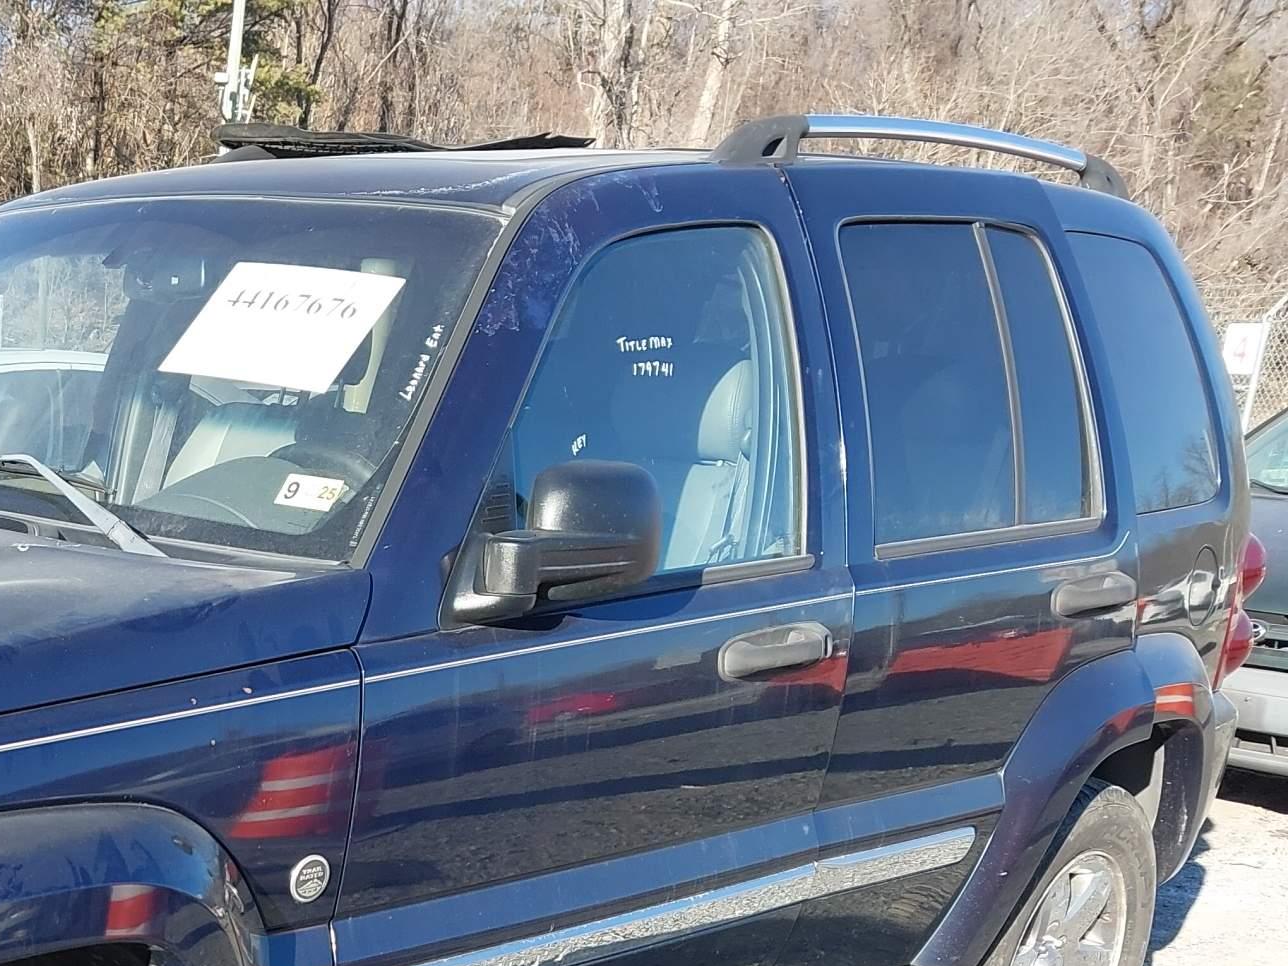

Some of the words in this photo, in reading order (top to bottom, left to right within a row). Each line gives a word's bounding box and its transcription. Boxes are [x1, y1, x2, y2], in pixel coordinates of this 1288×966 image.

[227, 288, 358, 320] 44167676
[632, 360, 674, 377] 179741
[571, 433, 587, 457] KEY
[284, 481, 301, 500] 9
[317, 485, 337, 501] 25
